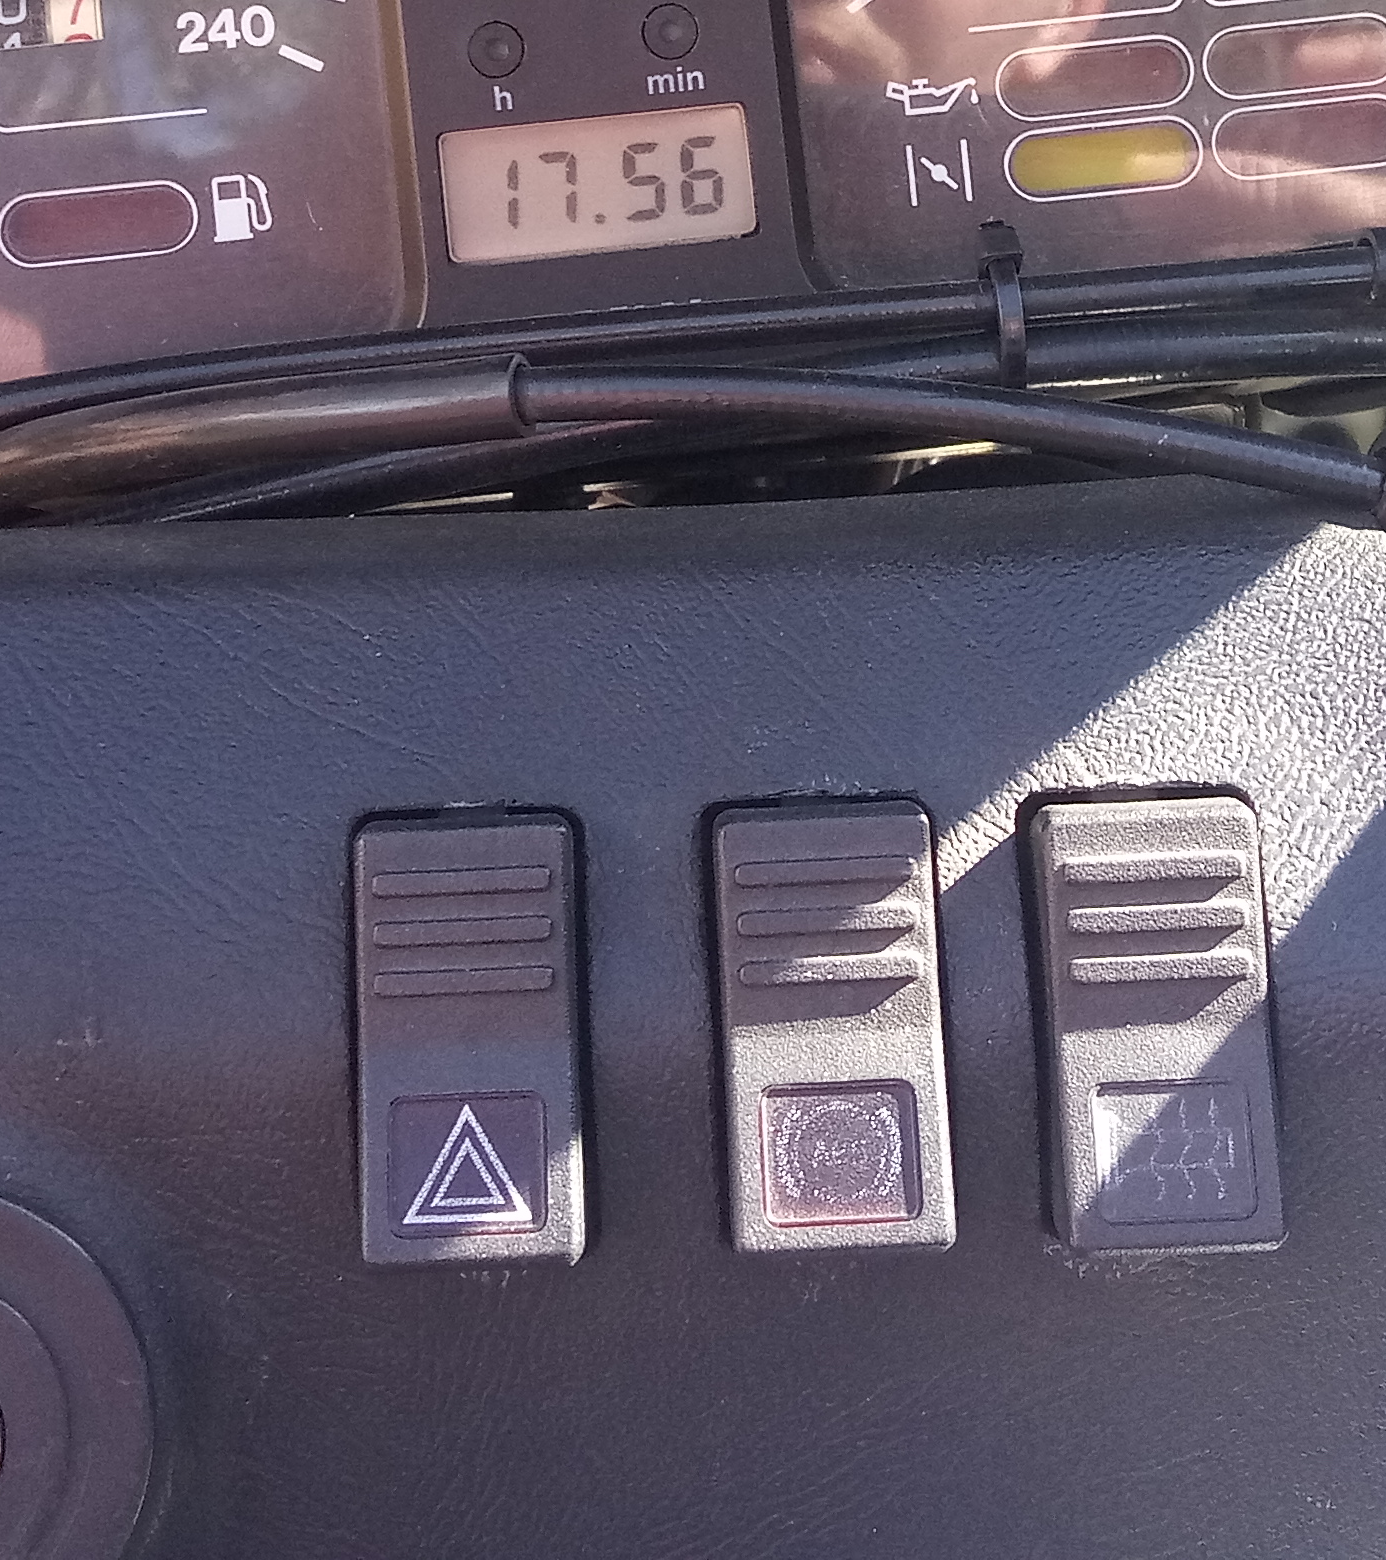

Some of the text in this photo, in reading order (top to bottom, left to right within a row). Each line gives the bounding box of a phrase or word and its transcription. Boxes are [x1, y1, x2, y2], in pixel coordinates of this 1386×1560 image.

[176, 5, 276, 54] 240
[494, 83, 513, 111] h
[646, 65, 705, 95] min
[506, 134, 726, 231] 17.56
